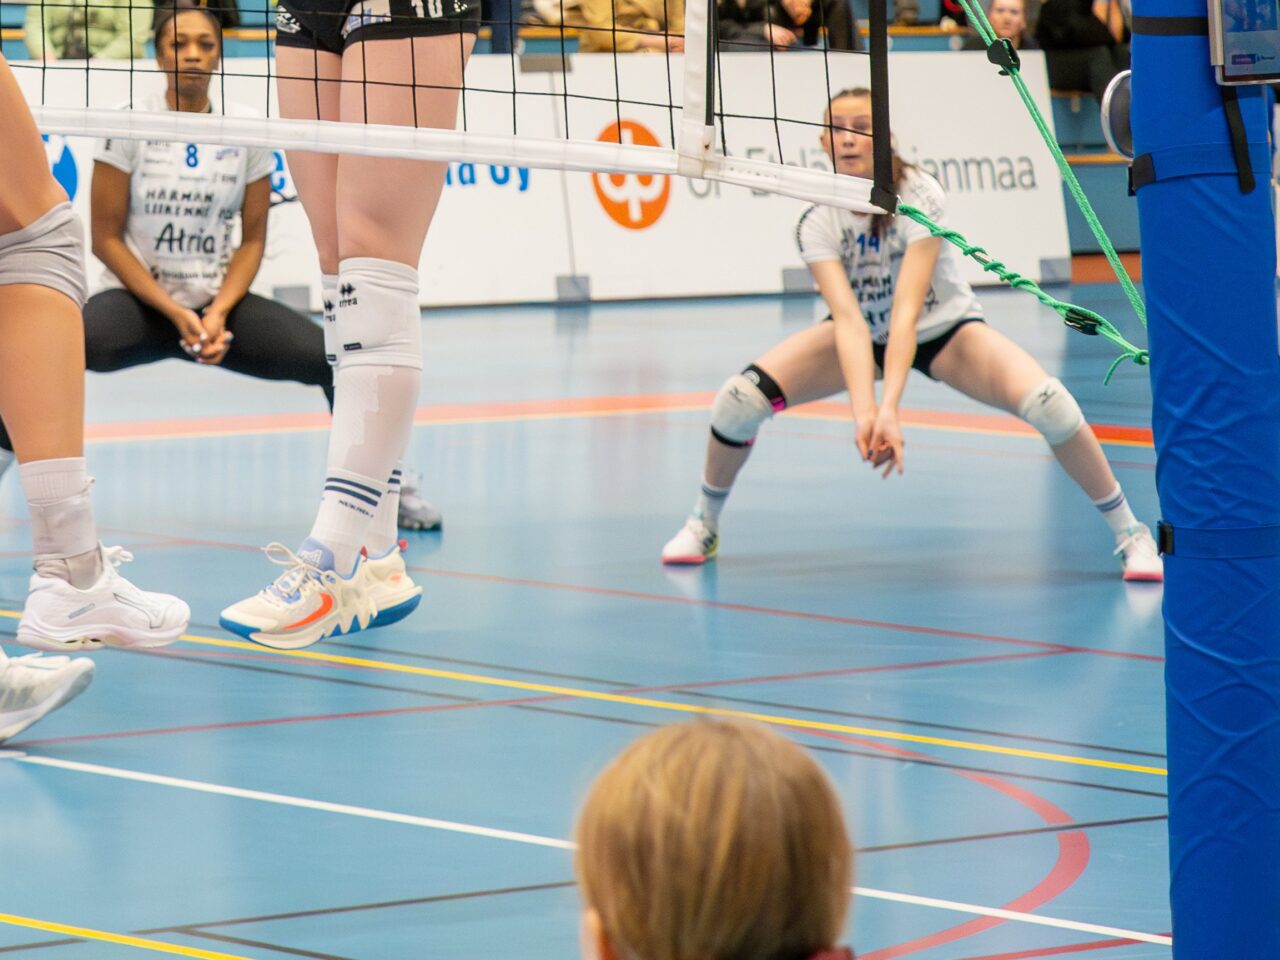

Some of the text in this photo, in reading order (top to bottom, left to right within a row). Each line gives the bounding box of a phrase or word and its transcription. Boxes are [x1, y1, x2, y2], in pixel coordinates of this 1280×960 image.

[185, 143, 199, 168] 8
[154, 221, 217, 254] Atria
[856, 233, 880, 257] 14
